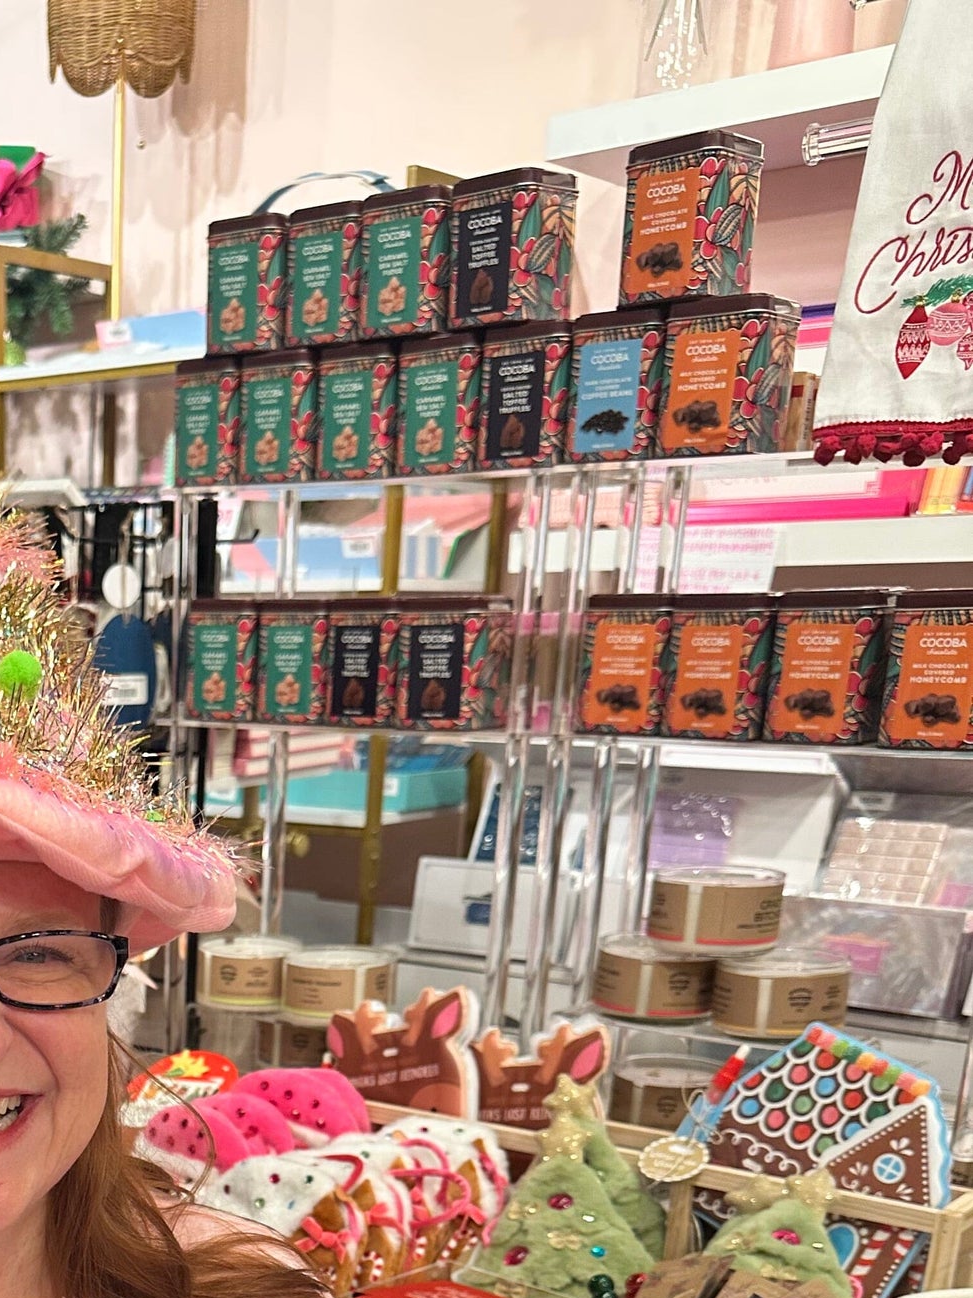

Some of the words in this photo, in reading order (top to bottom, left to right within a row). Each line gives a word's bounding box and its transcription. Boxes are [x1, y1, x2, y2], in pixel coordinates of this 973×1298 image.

[647, 184, 687, 199] COCOBA
[467, 215, 503, 229] COCOBA
[640, 222, 687, 236] HONEYCOMB
[686, 344, 727, 356] COCOBA
[591, 353, 629, 365] COCOBA
[498, 364, 536, 376] COCOBA
[677, 382, 727, 392] HONEYCOMB
[606, 634, 646, 645] COCOBA
[691, 636, 731, 647] COCOBA
[797, 634, 840, 646] COCOBA
[919, 638, 967, 648] COCOBA
[910, 676, 967, 684] HONEYCOMB
